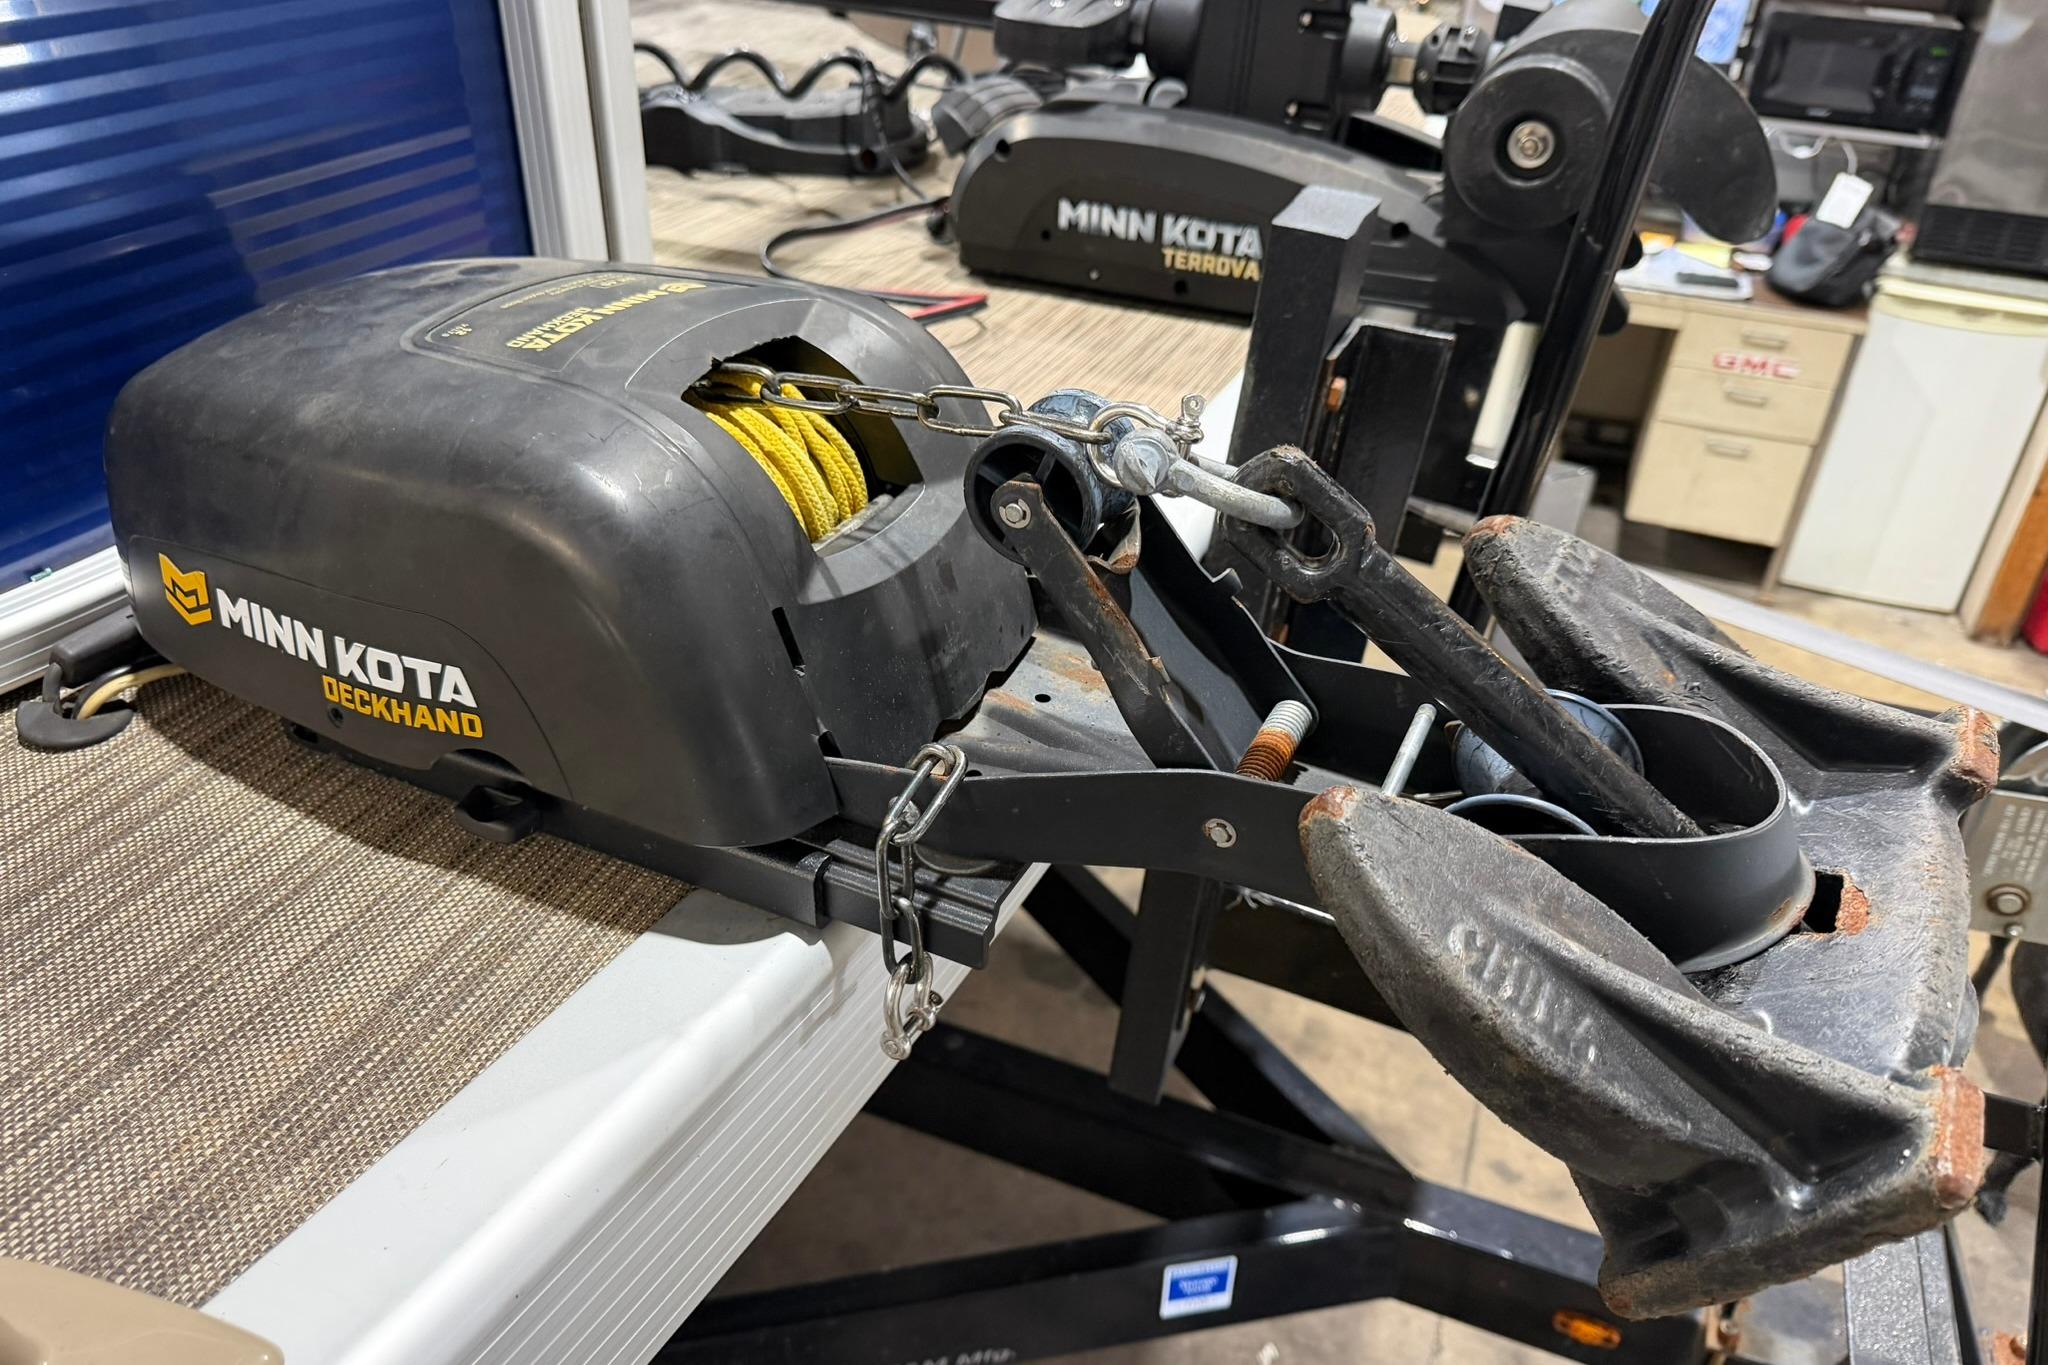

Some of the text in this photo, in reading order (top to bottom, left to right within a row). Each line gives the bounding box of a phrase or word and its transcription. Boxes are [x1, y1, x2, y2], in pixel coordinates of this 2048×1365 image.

[1057, 197, 1264, 260] MINN KOTA
[1162, 247, 1262, 281] TERROVA
[592, 289, 669, 315] MINN
[506, 306, 593, 347] DECKHAND
[522, 313, 603, 349] KOTA
[1712, 351, 1801, 380] GMC
[215, 588, 478, 709] MINN KOTA
[321, 674, 485, 739] DECKHAND
